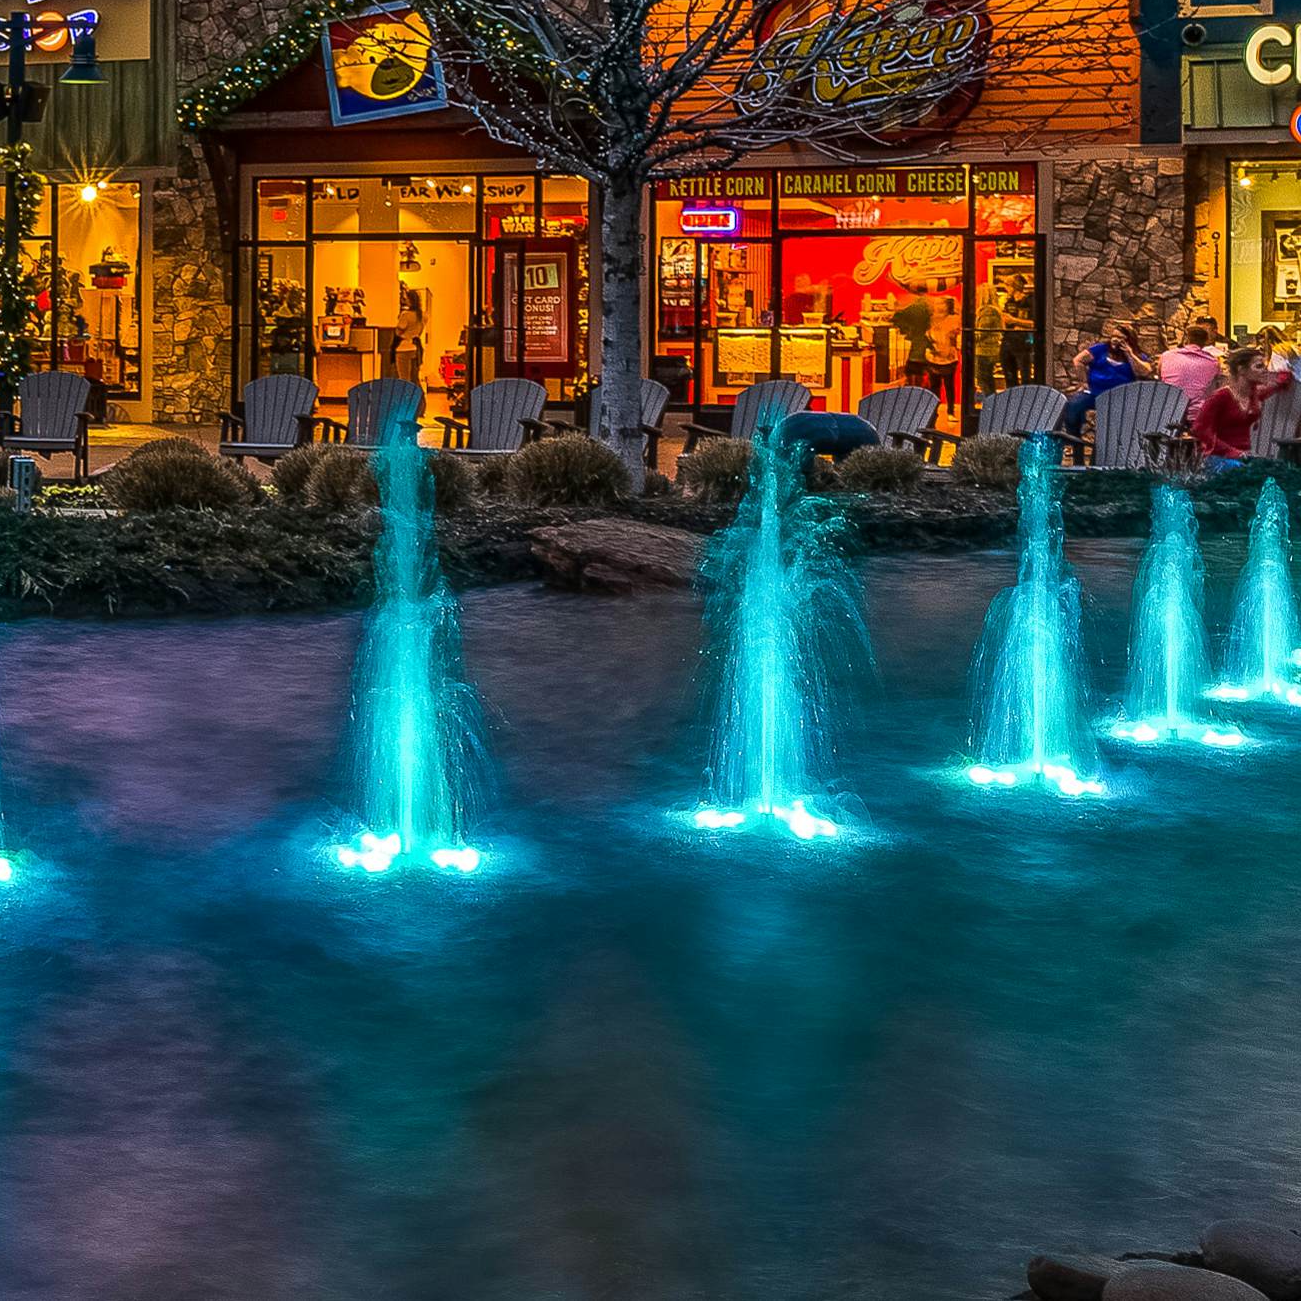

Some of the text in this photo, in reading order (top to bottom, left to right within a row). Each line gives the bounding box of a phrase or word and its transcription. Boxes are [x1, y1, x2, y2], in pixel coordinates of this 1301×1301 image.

[669, 176, 765, 197] KETTLE CORN
[784, 171, 1020, 194] CARAMEL CORN CHEESE CORN
[534, 295, 560, 304] CARD
